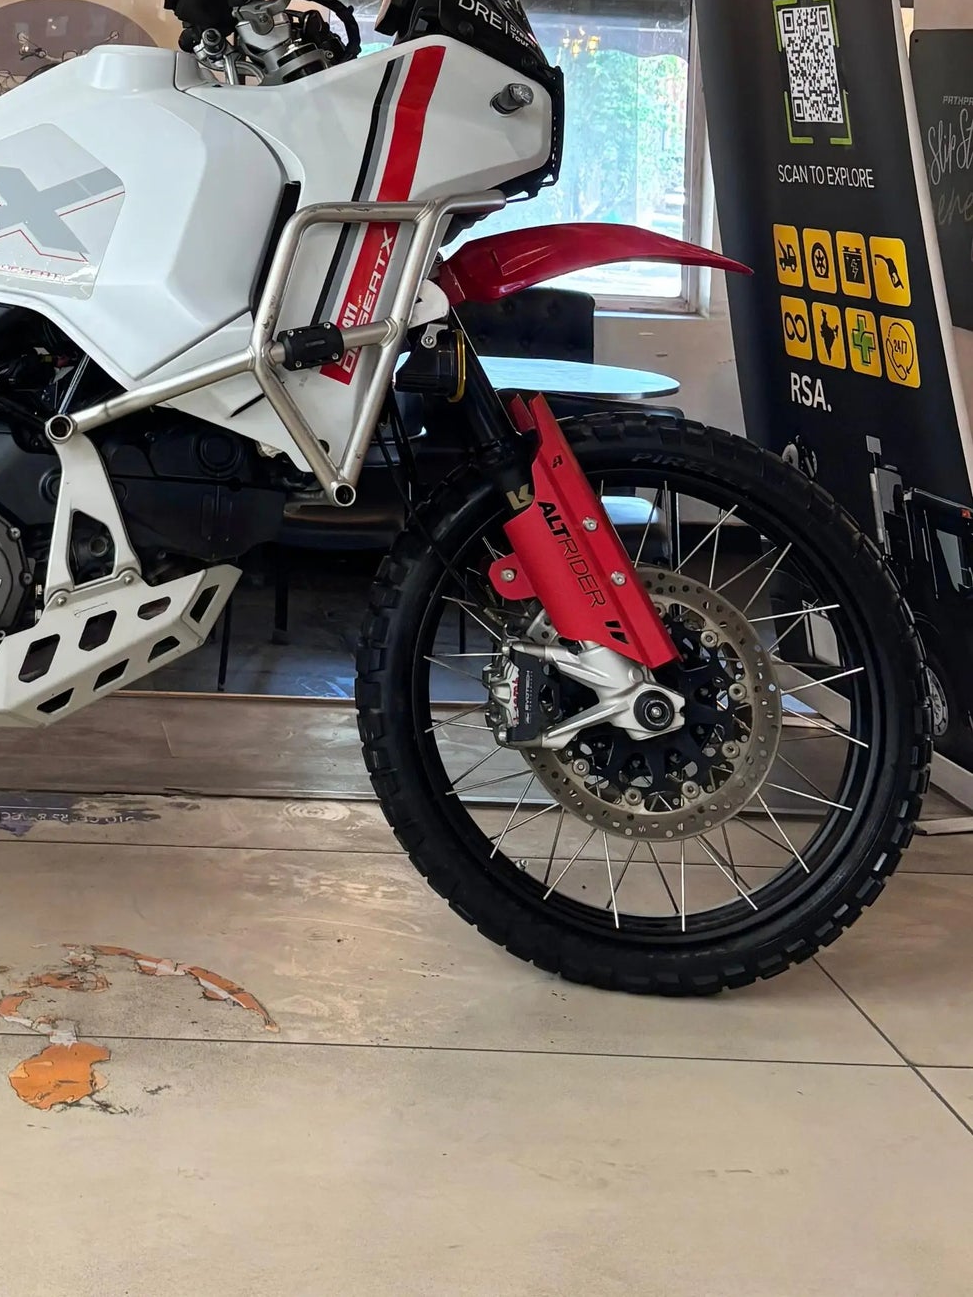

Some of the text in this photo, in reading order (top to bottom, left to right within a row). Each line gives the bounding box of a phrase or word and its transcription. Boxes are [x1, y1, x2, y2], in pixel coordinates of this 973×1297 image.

[778, 164, 875, 189] SCAN TO EXPLORE
[893, 338, 908, 358] 24/7
[790, 371, 832, 412] RSA.
[537, 501, 606, 609] ALTRIDER
